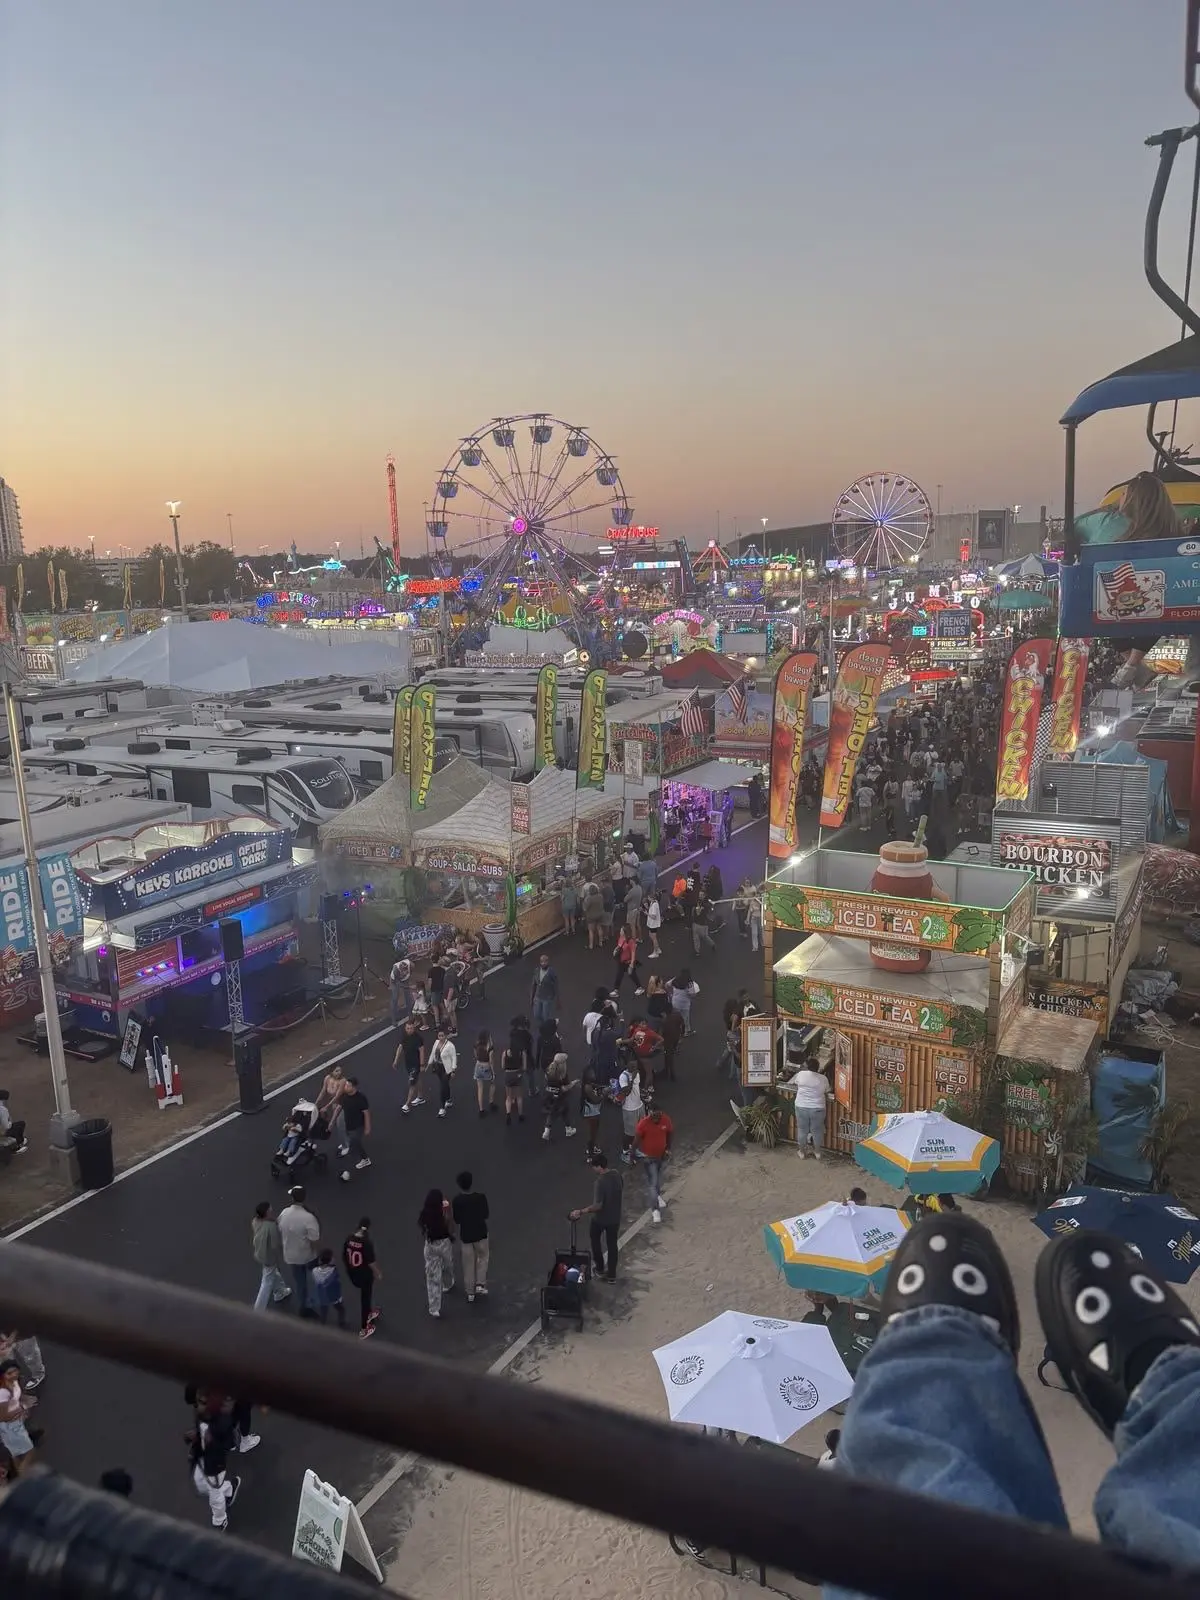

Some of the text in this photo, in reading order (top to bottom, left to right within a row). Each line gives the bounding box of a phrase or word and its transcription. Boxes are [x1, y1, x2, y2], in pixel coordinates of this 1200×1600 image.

[606, 526, 660, 539] CRAZY MOUSE
[1173, 578, 1200, 590] AME
[889, 584, 981, 610] JUMBO
[939, 615, 970, 627] FRENCH
[1171, 609, 1200, 617] FLOR
[943, 626, 966, 636] FRIES
[26, 653, 49, 669] BEER
[998, 677, 1035, 797] CHICKEN
[238, 839, 267, 856] AFTER
[1005, 844, 1104, 867] BOURBON
[241, 851, 267, 867] DARK
[136, 853, 234, 898] KEYS KARAOKE
[47, 860, 75, 926] RIDE
[0, 873, 25, 942] RIDE
[836, 901, 870, 911] FRESH
[873, 905, 919, 917] BREWED
[838, 910, 915, 934] ICED TEA
[921, 915, 932, 940] 2
[932, 932, 947, 940] CUP
[836, 988, 917, 1008] FRESH BREWED
[1039, 993, 1091, 1010] CHICKEN
[1093, 1000, 1105, 1011] &
[838, 997, 914, 1024] ICED TEA
[920, 1007, 930, 1030] 2
[930, 1023, 944, 1032] CUP
[875, 1059, 905, 1072] ICED
[876, 1069, 902, 1084] TEA
[935, 1070, 967, 1085] ICED
[1007, 1085, 1039, 1101] FREE
[920, 1145, 956, 1154] CRUISER
[926, 1138, 945, 1146] SUN
[863, 1228, 881, 1239] SUN
[863, 1231, 896, 1249] CRUISER
[347, 1247, 363, 1267] 10
[679, 1355, 699, 1364] WHITE
[779, 1375, 805, 1406] WHITE CLAW
